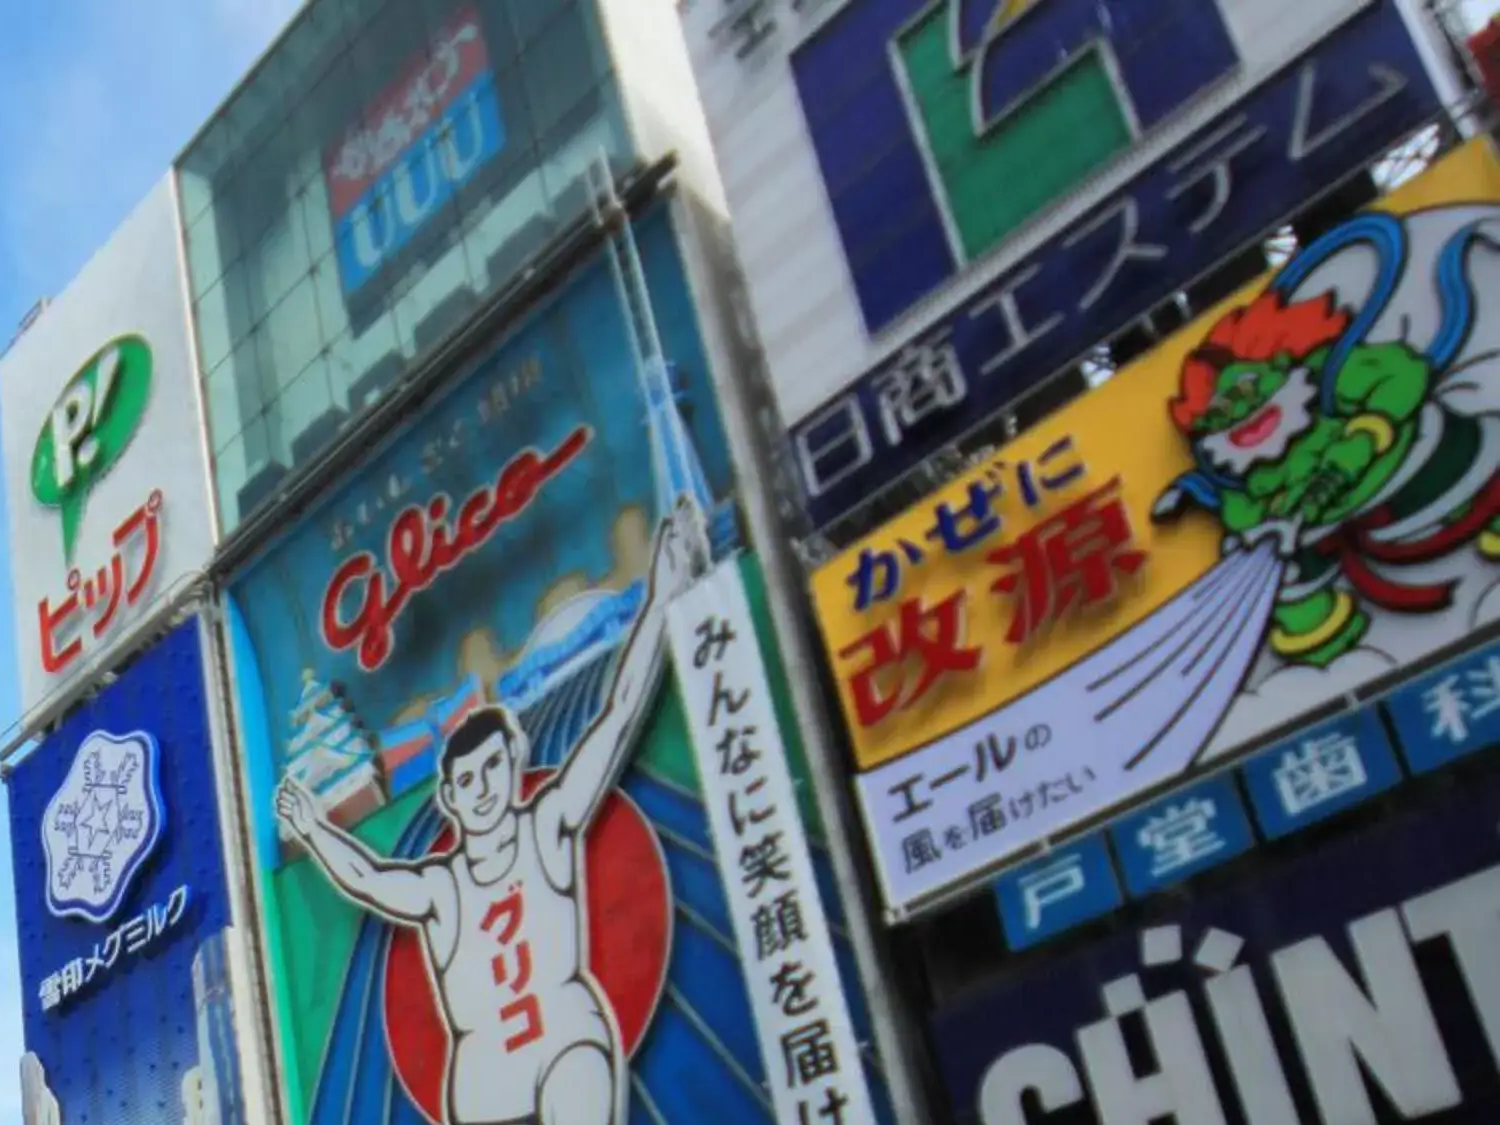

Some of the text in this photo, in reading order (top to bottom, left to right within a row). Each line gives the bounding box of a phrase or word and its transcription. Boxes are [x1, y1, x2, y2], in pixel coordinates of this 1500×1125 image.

[797, 60, 1410, 497] 日商エステム
[38, 488, 163, 673] ピップ
[837, 475, 1152, 729] 改源
[845, 436, 1088, 611] かぜに
[887, 722, 1053, 824] エールの
[900, 766, 1098, 874] 風を届けたい
[38, 884, 190, 1013] 雪印メグミルク
[479, 879, 544, 1054] グリコ
